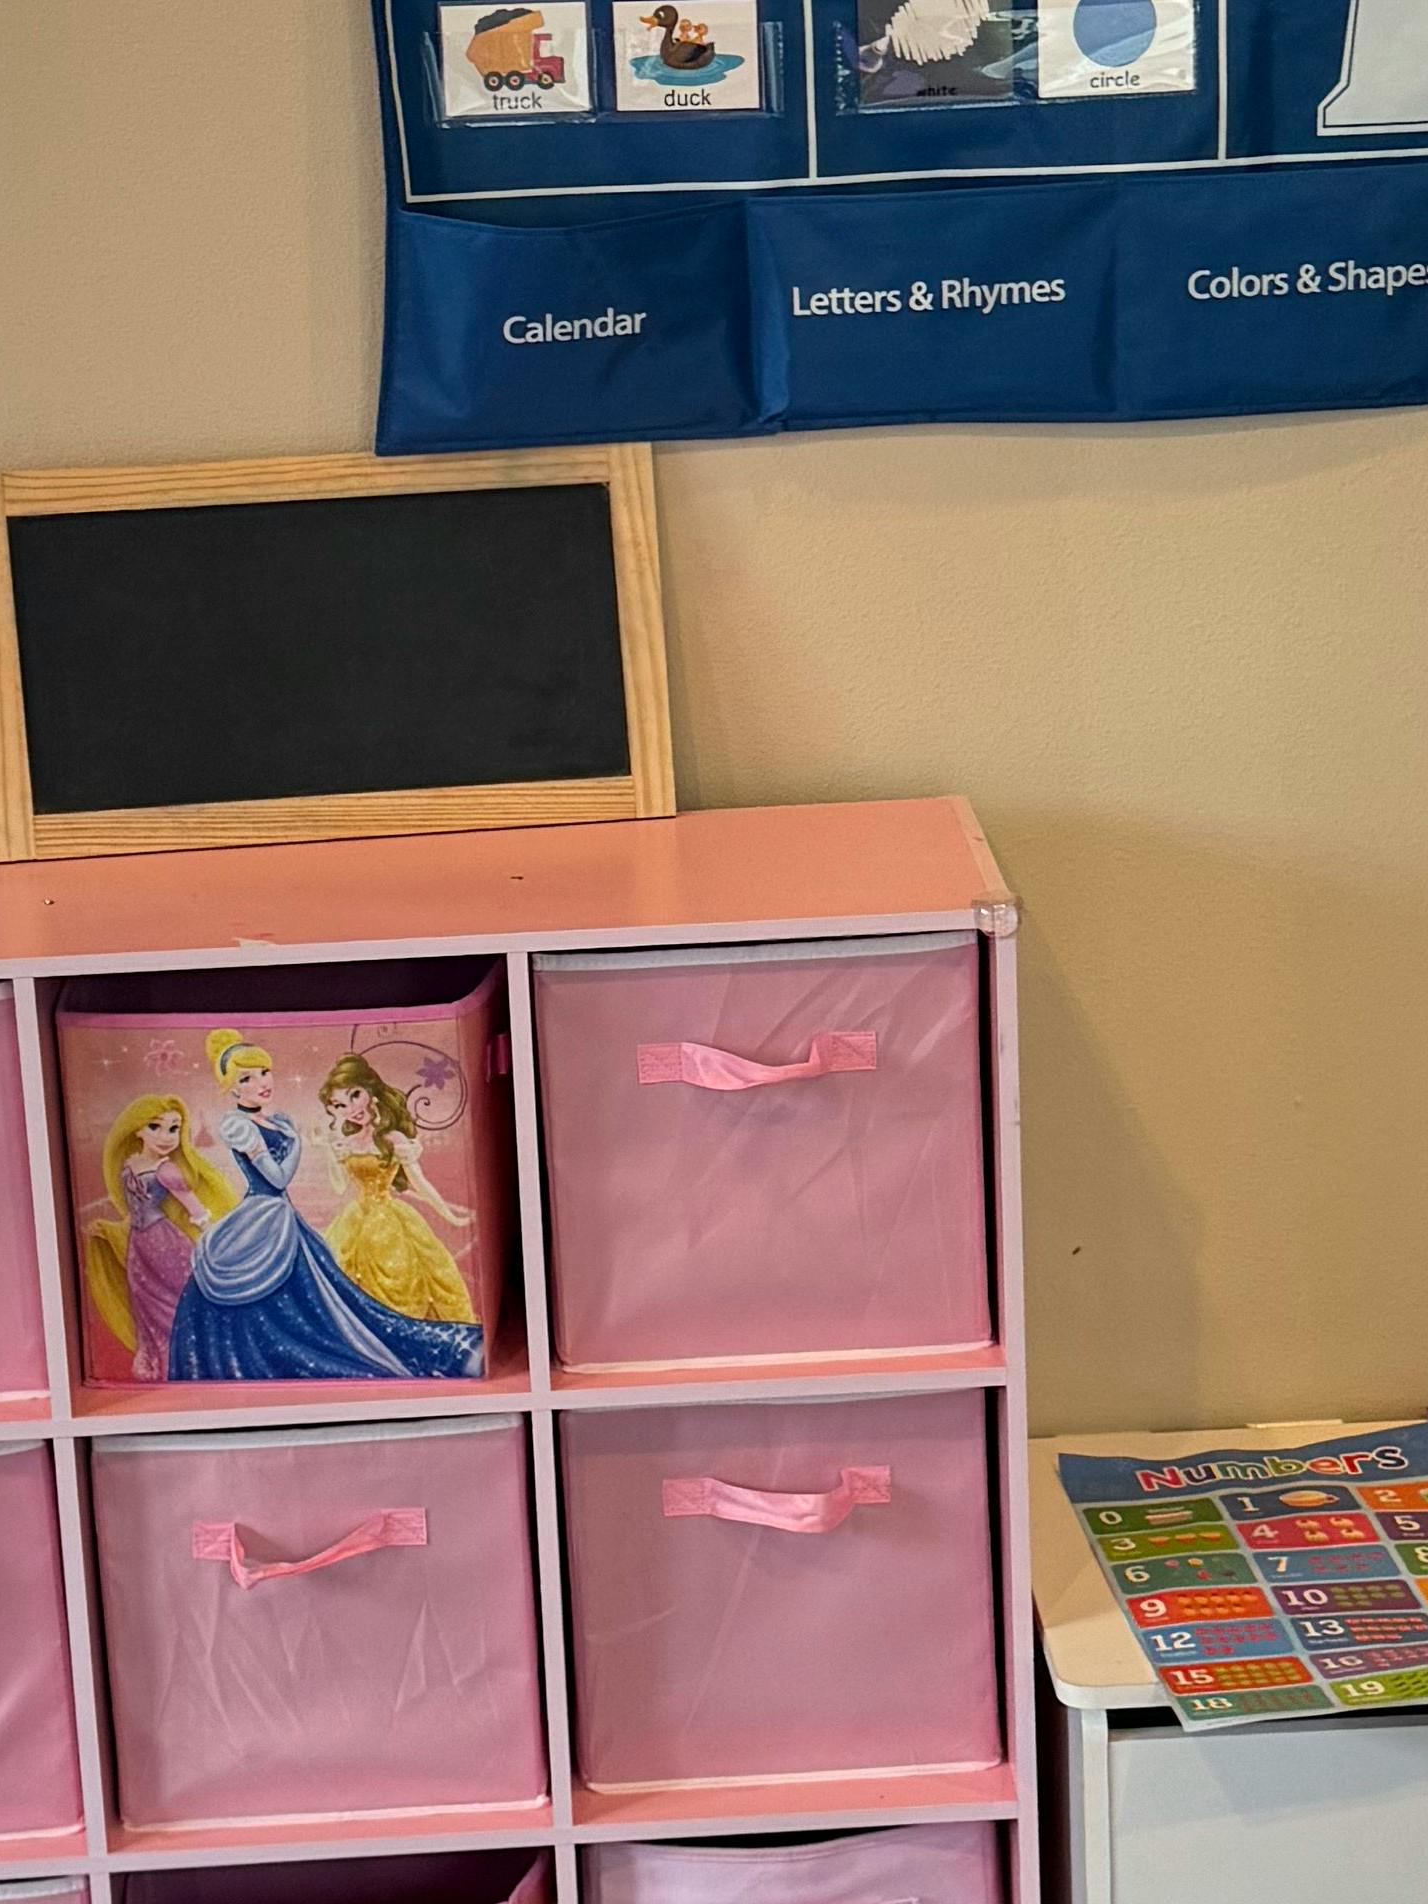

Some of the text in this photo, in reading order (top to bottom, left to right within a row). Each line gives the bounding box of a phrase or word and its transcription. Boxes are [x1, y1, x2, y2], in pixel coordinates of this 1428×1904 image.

[1090, 72, 1140, 88] circle
[492, 90, 542, 111] truck
[663, 86, 711, 107] duck
[1188, 268, 1289, 301] Colors
[1297, 264, 1322, 294] &
[792, 276, 1065, 318] Letters & Rhymes
[503, 308, 645, 345] Calendar
[1136, 1446, 1408, 1491] Numbers
[1237, 1496, 1260, 1512] 1
[1374, 1489, 1402, 1502] 2
[1098, 1511, 1123, 1525] 0
[1394, 1515, 1420, 1530] 5
[1252, 1524, 1278, 1539] 4
[1110, 1537, 1137, 1551] 3
[1268, 1556, 1289, 1573] 7
[1124, 1565, 1150, 1583] 6
[1282, 1589, 1329, 1606] 10
[1140, 1599, 1167, 1617] 9
[1299, 1619, 1345, 1637] 13
[1150, 1631, 1197, 1652] 12
[1320, 1656, 1363, 1669] 16
[1171, 1669, 1215, 1686] 15
[1342, 1681, 1386, 1697] 19
[1189, 1697, 1233, 1711] 18
